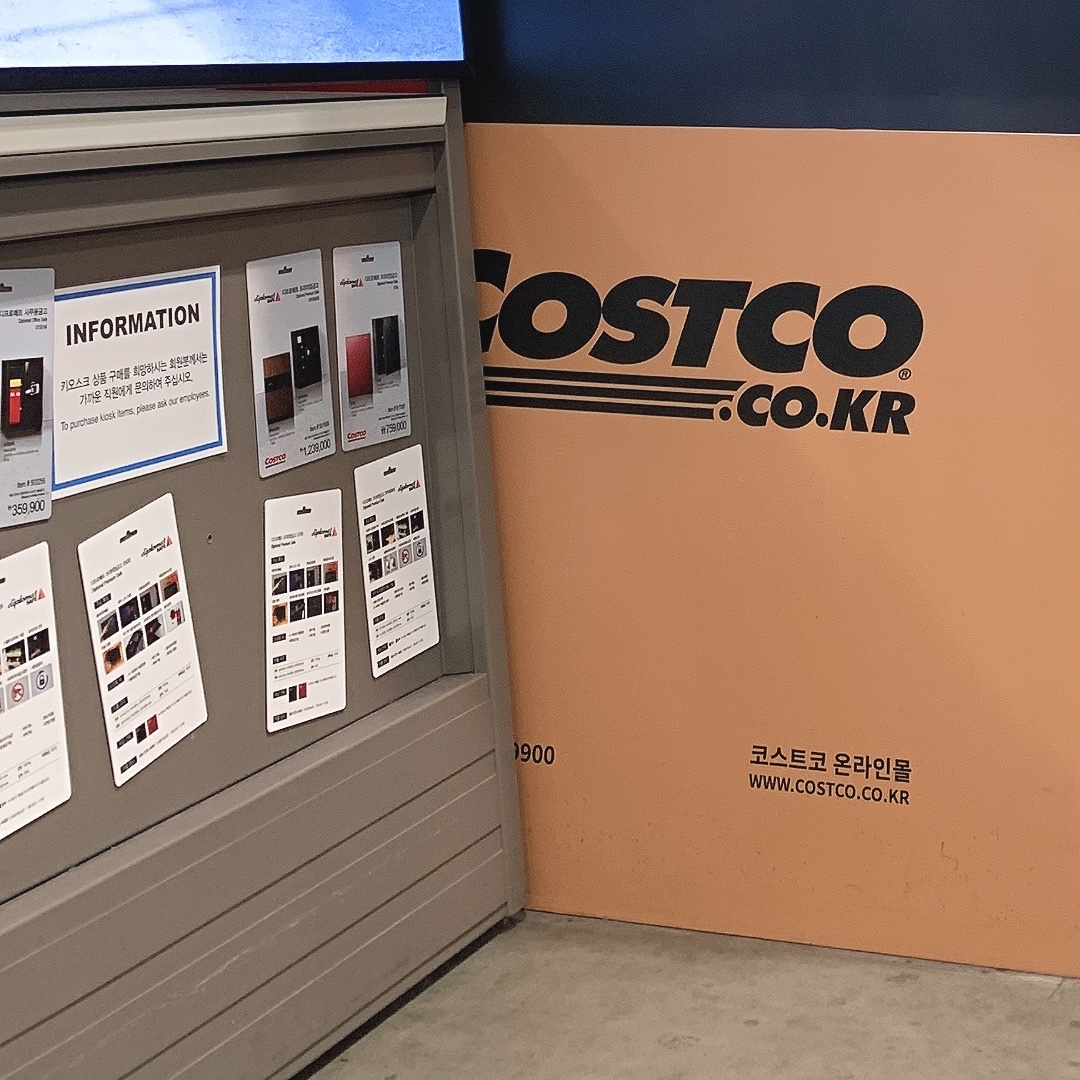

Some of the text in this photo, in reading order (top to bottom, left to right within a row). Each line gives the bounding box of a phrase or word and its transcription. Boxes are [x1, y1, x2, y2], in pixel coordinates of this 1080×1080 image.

[66, 302, 200, 346] INFORMATION
[60, 379, 90, 392] 키오스크
[92, 371, 107, 387] 상품
[108, 367, 131, 383] 구매를
[133, 360, 167, 377] 희망하시는
[79, 390, 101, 406] 가까운
[104, 383, 133, 400] 직원에게
[134, 377, 163, 395] 문의하여
[61, 421, 69, 432] To
[70, 413, 99, 431] purchase
[100, 410, 116, 422] kiosk
[117, 406, 135, 419] items,
[136, 402, 156, 416] please
[157, 398, 168, 409] ask
[168, 396, 179, 407] our
[719, 383, 917, 435] .CO.KR
[750, 744, 912, 784] 코스트코 온라인몰
[748, 773, 910, 806] WWW.COSTCO.CO.KR
